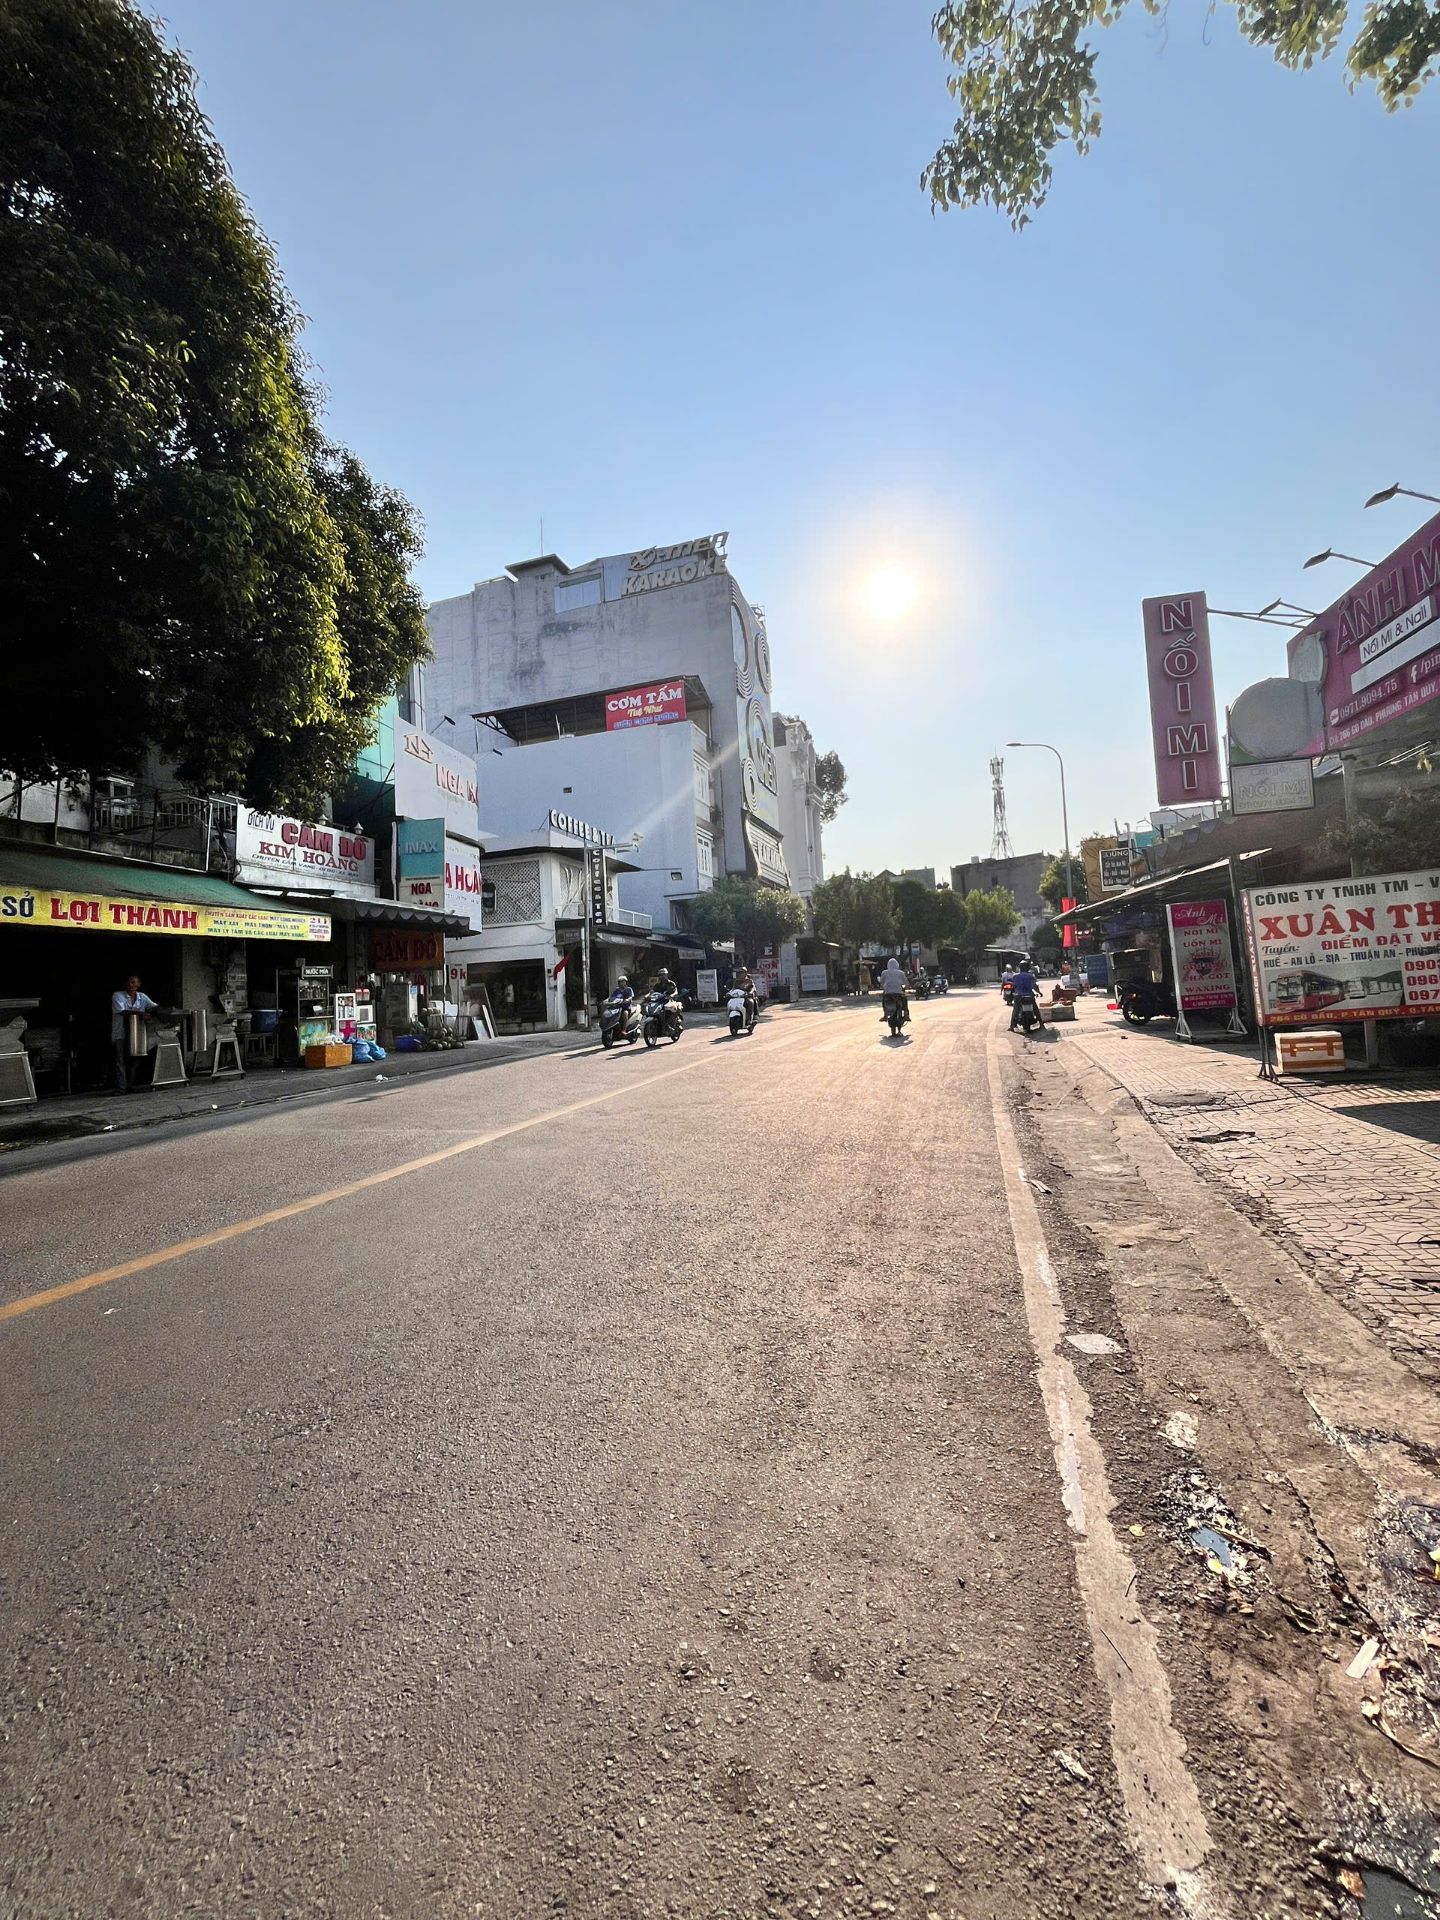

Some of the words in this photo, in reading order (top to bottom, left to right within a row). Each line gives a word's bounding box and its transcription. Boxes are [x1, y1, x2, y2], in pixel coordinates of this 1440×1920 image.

[621, 554, 728, 596] KARAOKE
[607, 695, 642, 711] CƠM
[646, 685, 682, 704] TẤM
[1340, 678, 1398, 719] 0971.9094.75
[550, 809, 592, 841] COFFEE
[258, 841, 296, 861] KIM
[302, 850, 359, 872] HOÀNG
[338, 835, 368, 861] ĐỒ
[405, 840, 439, 855] INAX
[411, 882, 432, 896] NGA
[1255, 891, 1300, 907] CÔNG
[1304, 888, 1325, 901] TY
[1332, 885, 1376, 899] TNHH
[1381, 880, 1409, 893] TM
[2, 891, 35, 918] SỞ
[50, 898, 101, 925] LỢI
[1258, 903, 1376, 941] XUÂN
[1321, 934, 1369, 951] ĐIỂM
[1376, 932, 1414, 948] ĐẶT
[1291, 954, 1304, 966] AN
[1350, 949, 1380, 963] THUẬN
[1383, 949, 1396, 958] AN
[1184, 983, 1231, 993] WAXING
